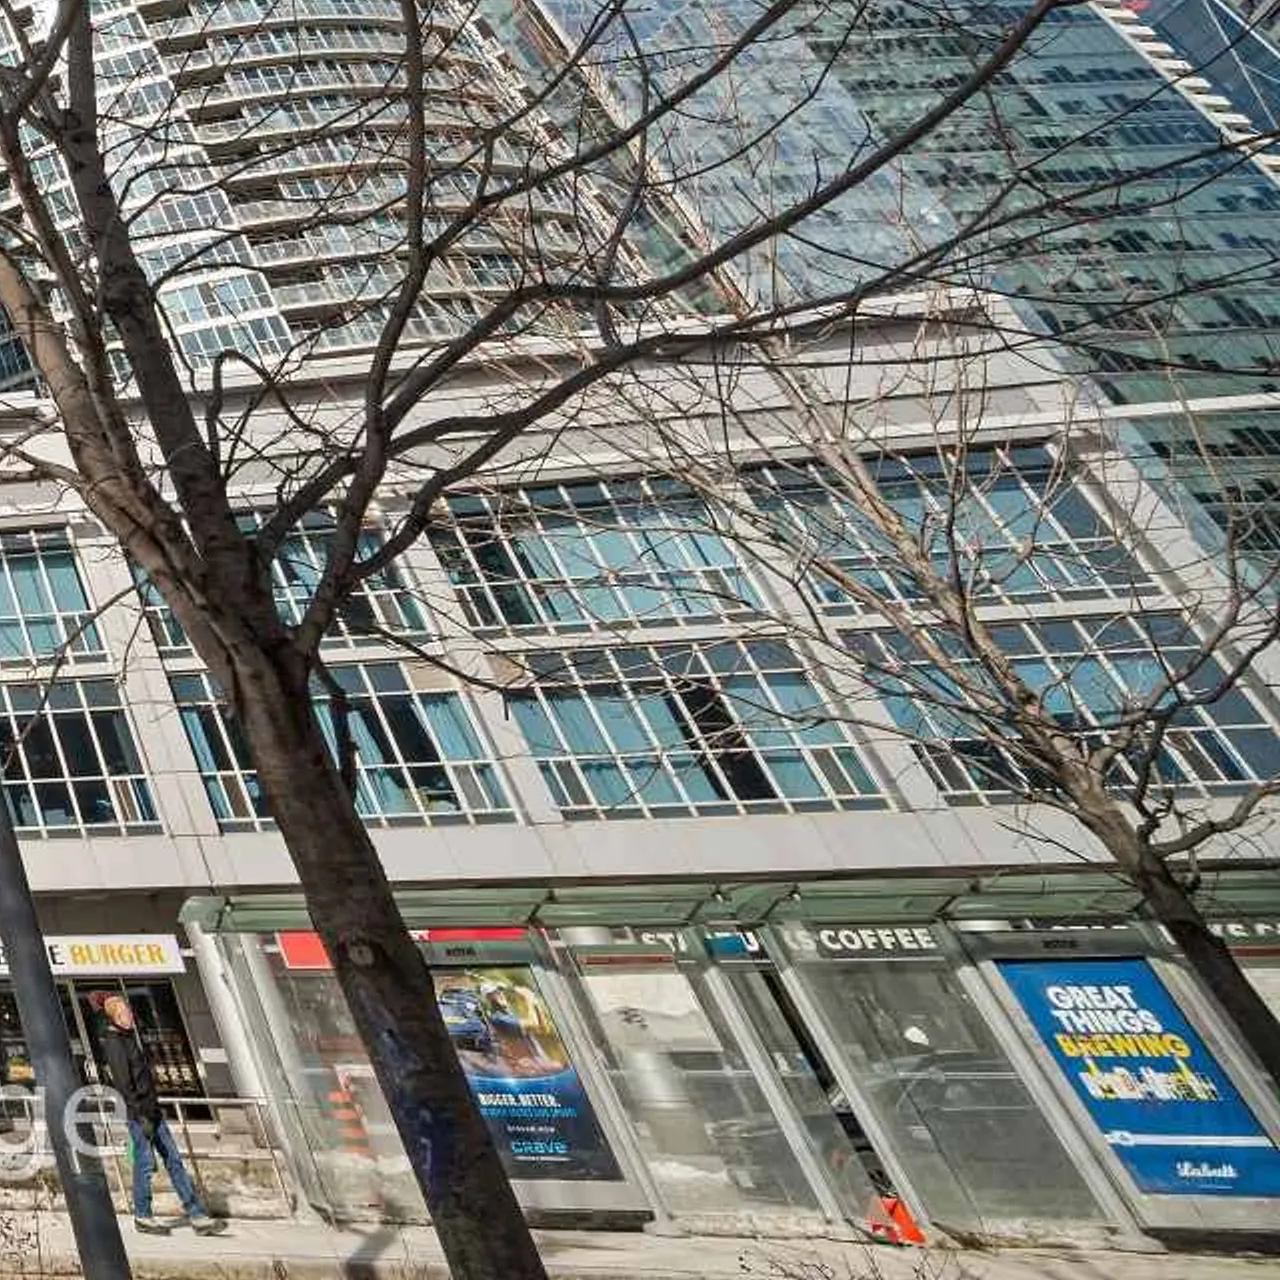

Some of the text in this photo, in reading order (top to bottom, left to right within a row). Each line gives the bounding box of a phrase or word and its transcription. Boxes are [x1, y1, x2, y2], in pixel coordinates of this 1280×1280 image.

[820, 927, 938, 951] COFFEE
[69, 943, 165, 966] BURGER
[1046, 985, 1138, 1010] GREAT
[1051, 1009, 1163, 1033] THINGS
[1054, 1033, 1192, 1057] BREWING
